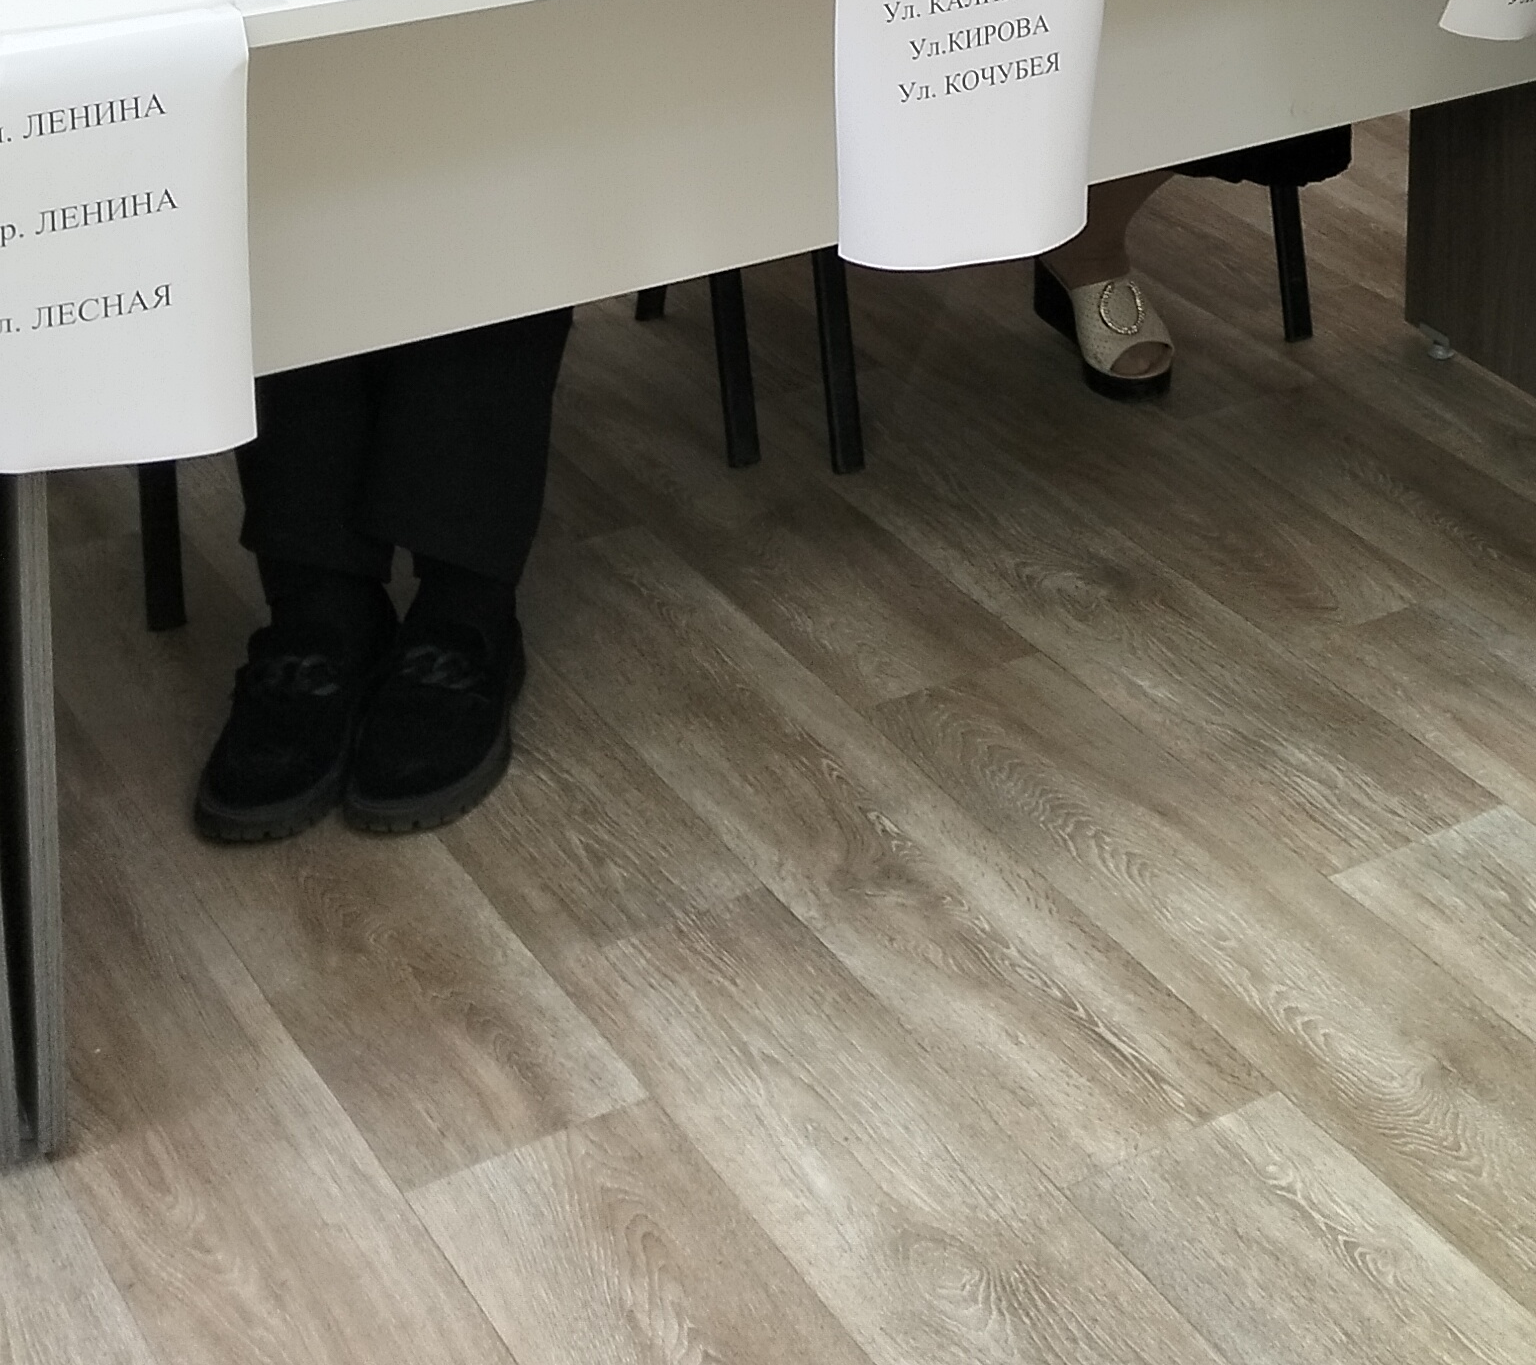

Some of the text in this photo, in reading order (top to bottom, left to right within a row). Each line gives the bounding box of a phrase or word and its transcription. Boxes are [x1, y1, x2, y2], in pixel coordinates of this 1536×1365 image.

[883, 1, 921, 24] Ул.
[909, 14, 1050, 60] Ул.КИРОВА
[898, 51, 1061, 103] Ул. КОЧУБЕЯ
[22, 93, 168, 139] ЛЕНИНА
[35, 188, 180, 236] ЛЕНИНА
[31, 283, 173, 330] ЛЕСНАЯ
